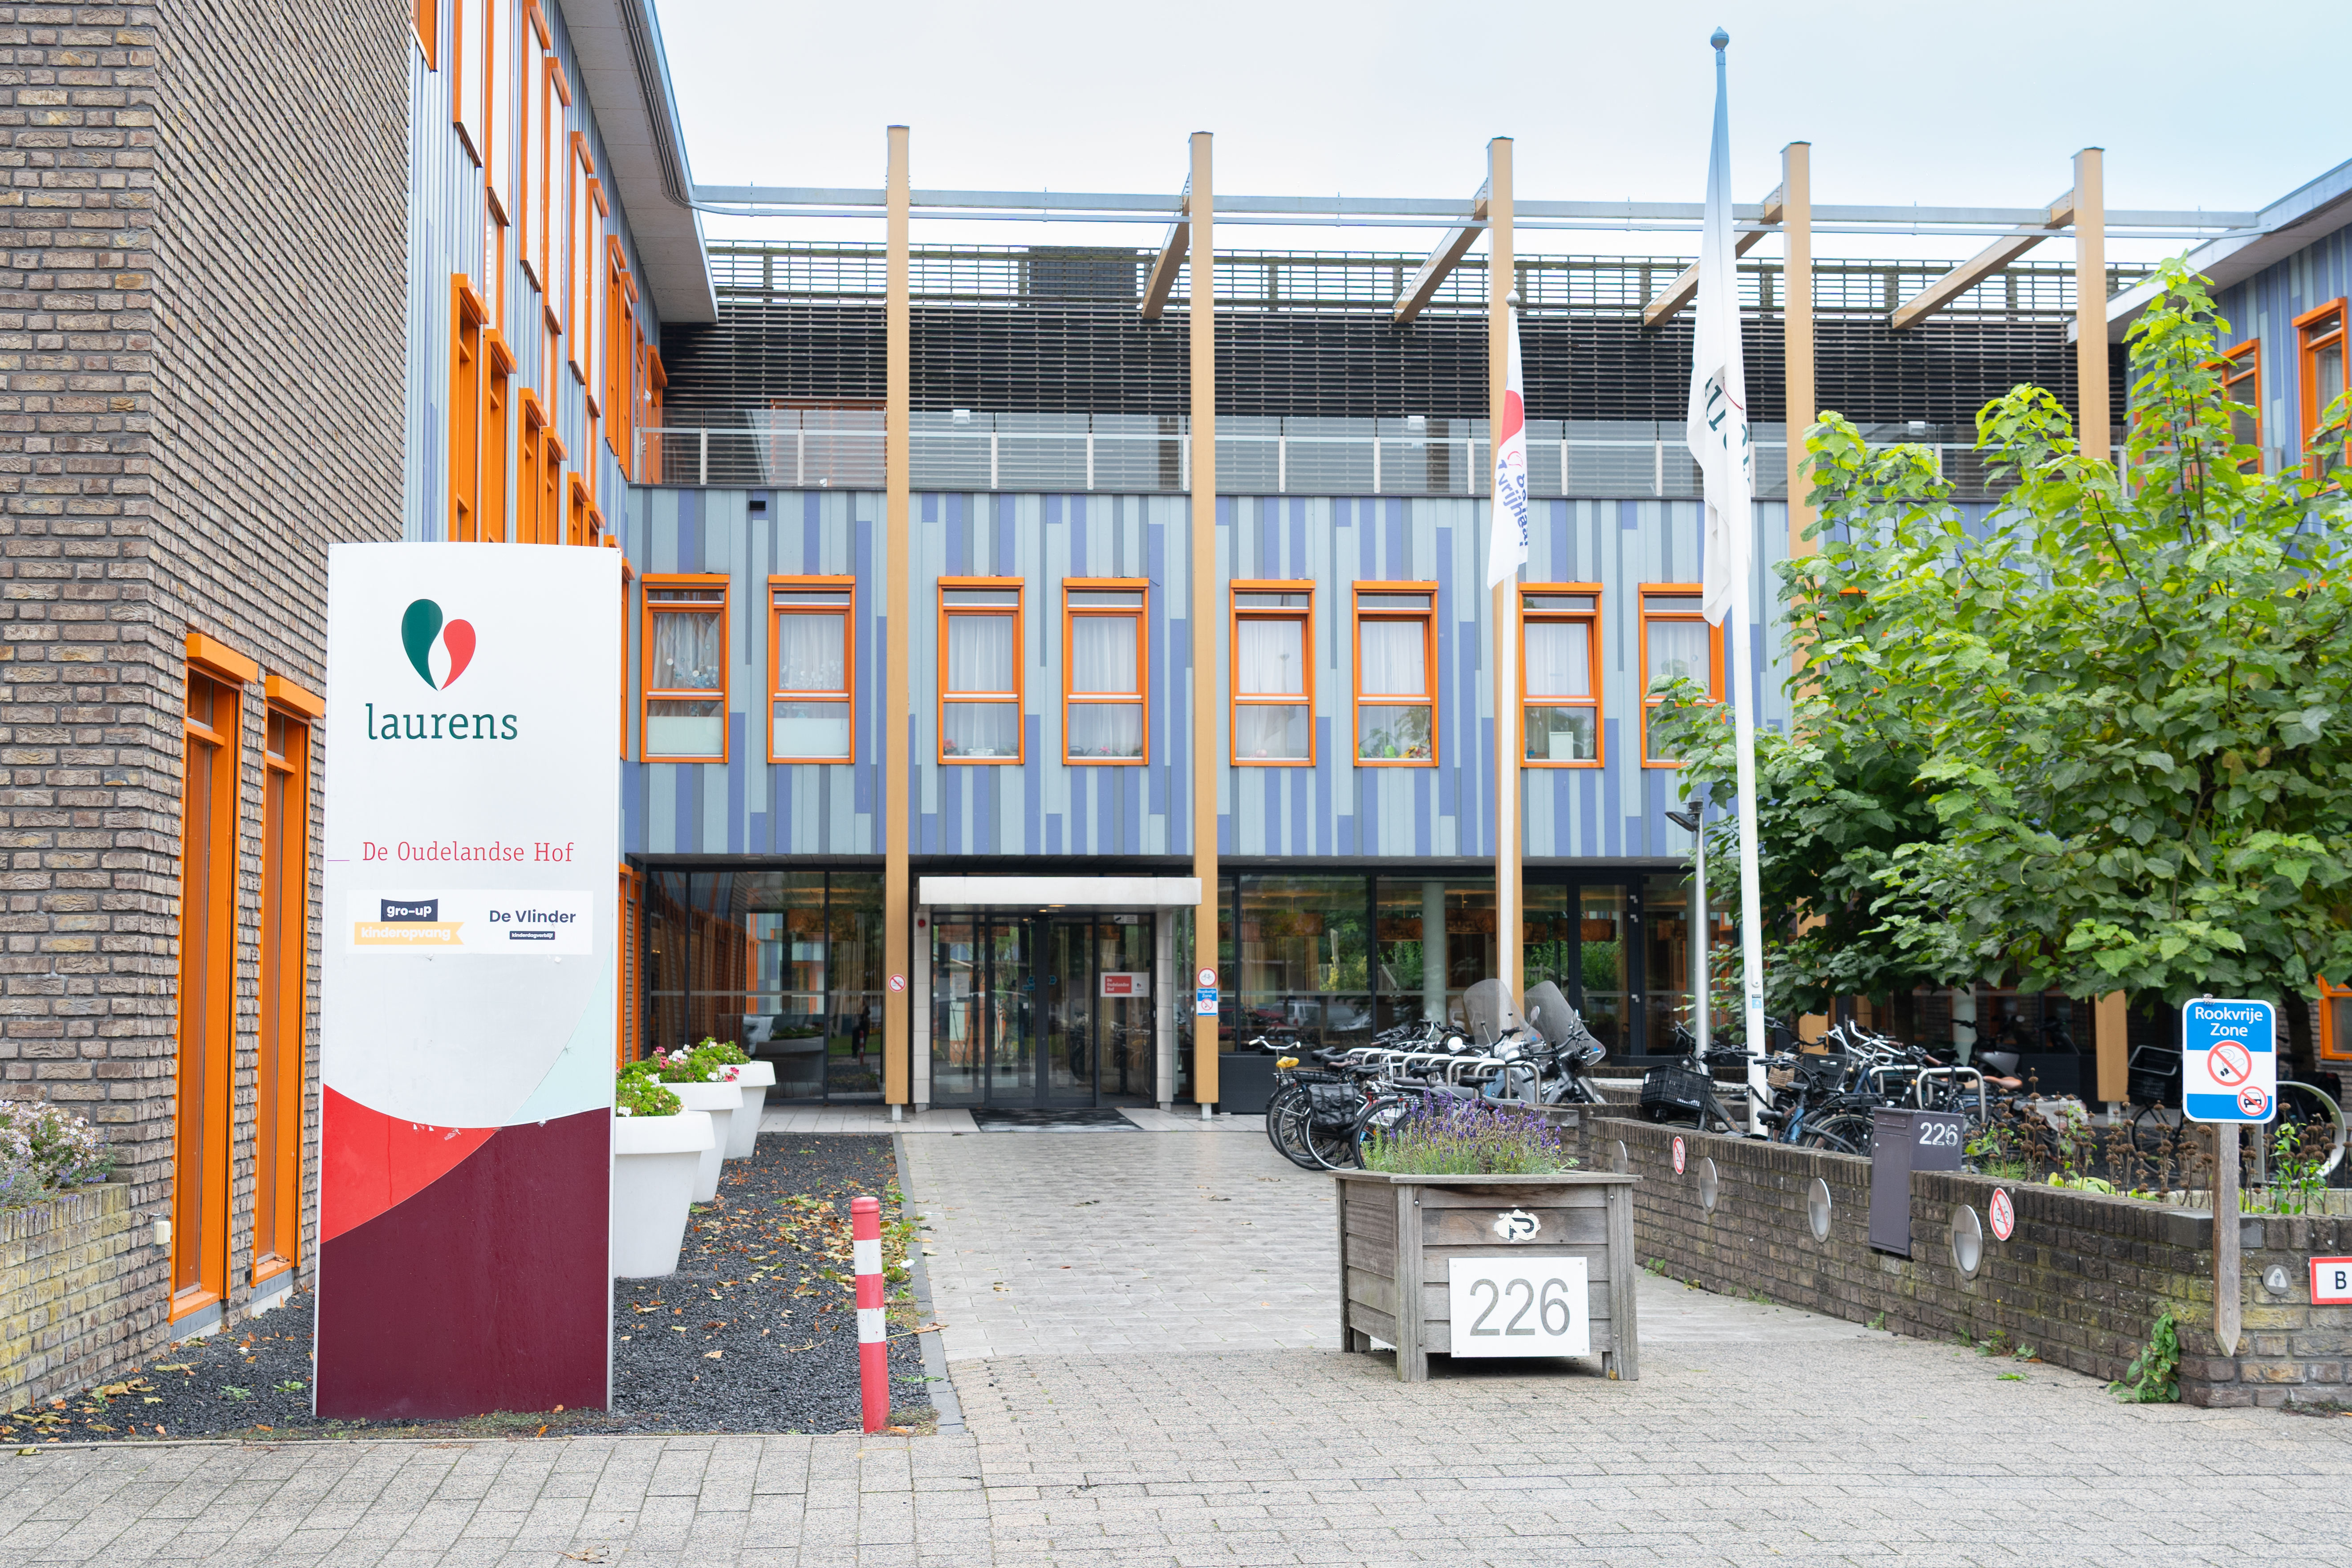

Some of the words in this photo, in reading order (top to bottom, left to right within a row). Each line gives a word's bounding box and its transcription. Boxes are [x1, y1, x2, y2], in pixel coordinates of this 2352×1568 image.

[366, 703, 518, 740] laurens
[363, 841, 388, 861] De
[397, 841, 524, 861] Oudelandse
[535, 841, 574, 862] Hof
[386, 905, 432, 918] gro-up
[489, 910, 511, 923] De
[515, 909, 576, 923] Vlinder
[361, 926, 451, 941] kinderopvang
[2195, 1006, 2263, 1024] Rookvrije
[2210, 1023, 2248, 1037] Zone
[1919, 1122, 1958, 1146] 226
[2335, 1271, 2347, 1289] B
[1470, 1278, 1570, 1336] 226
